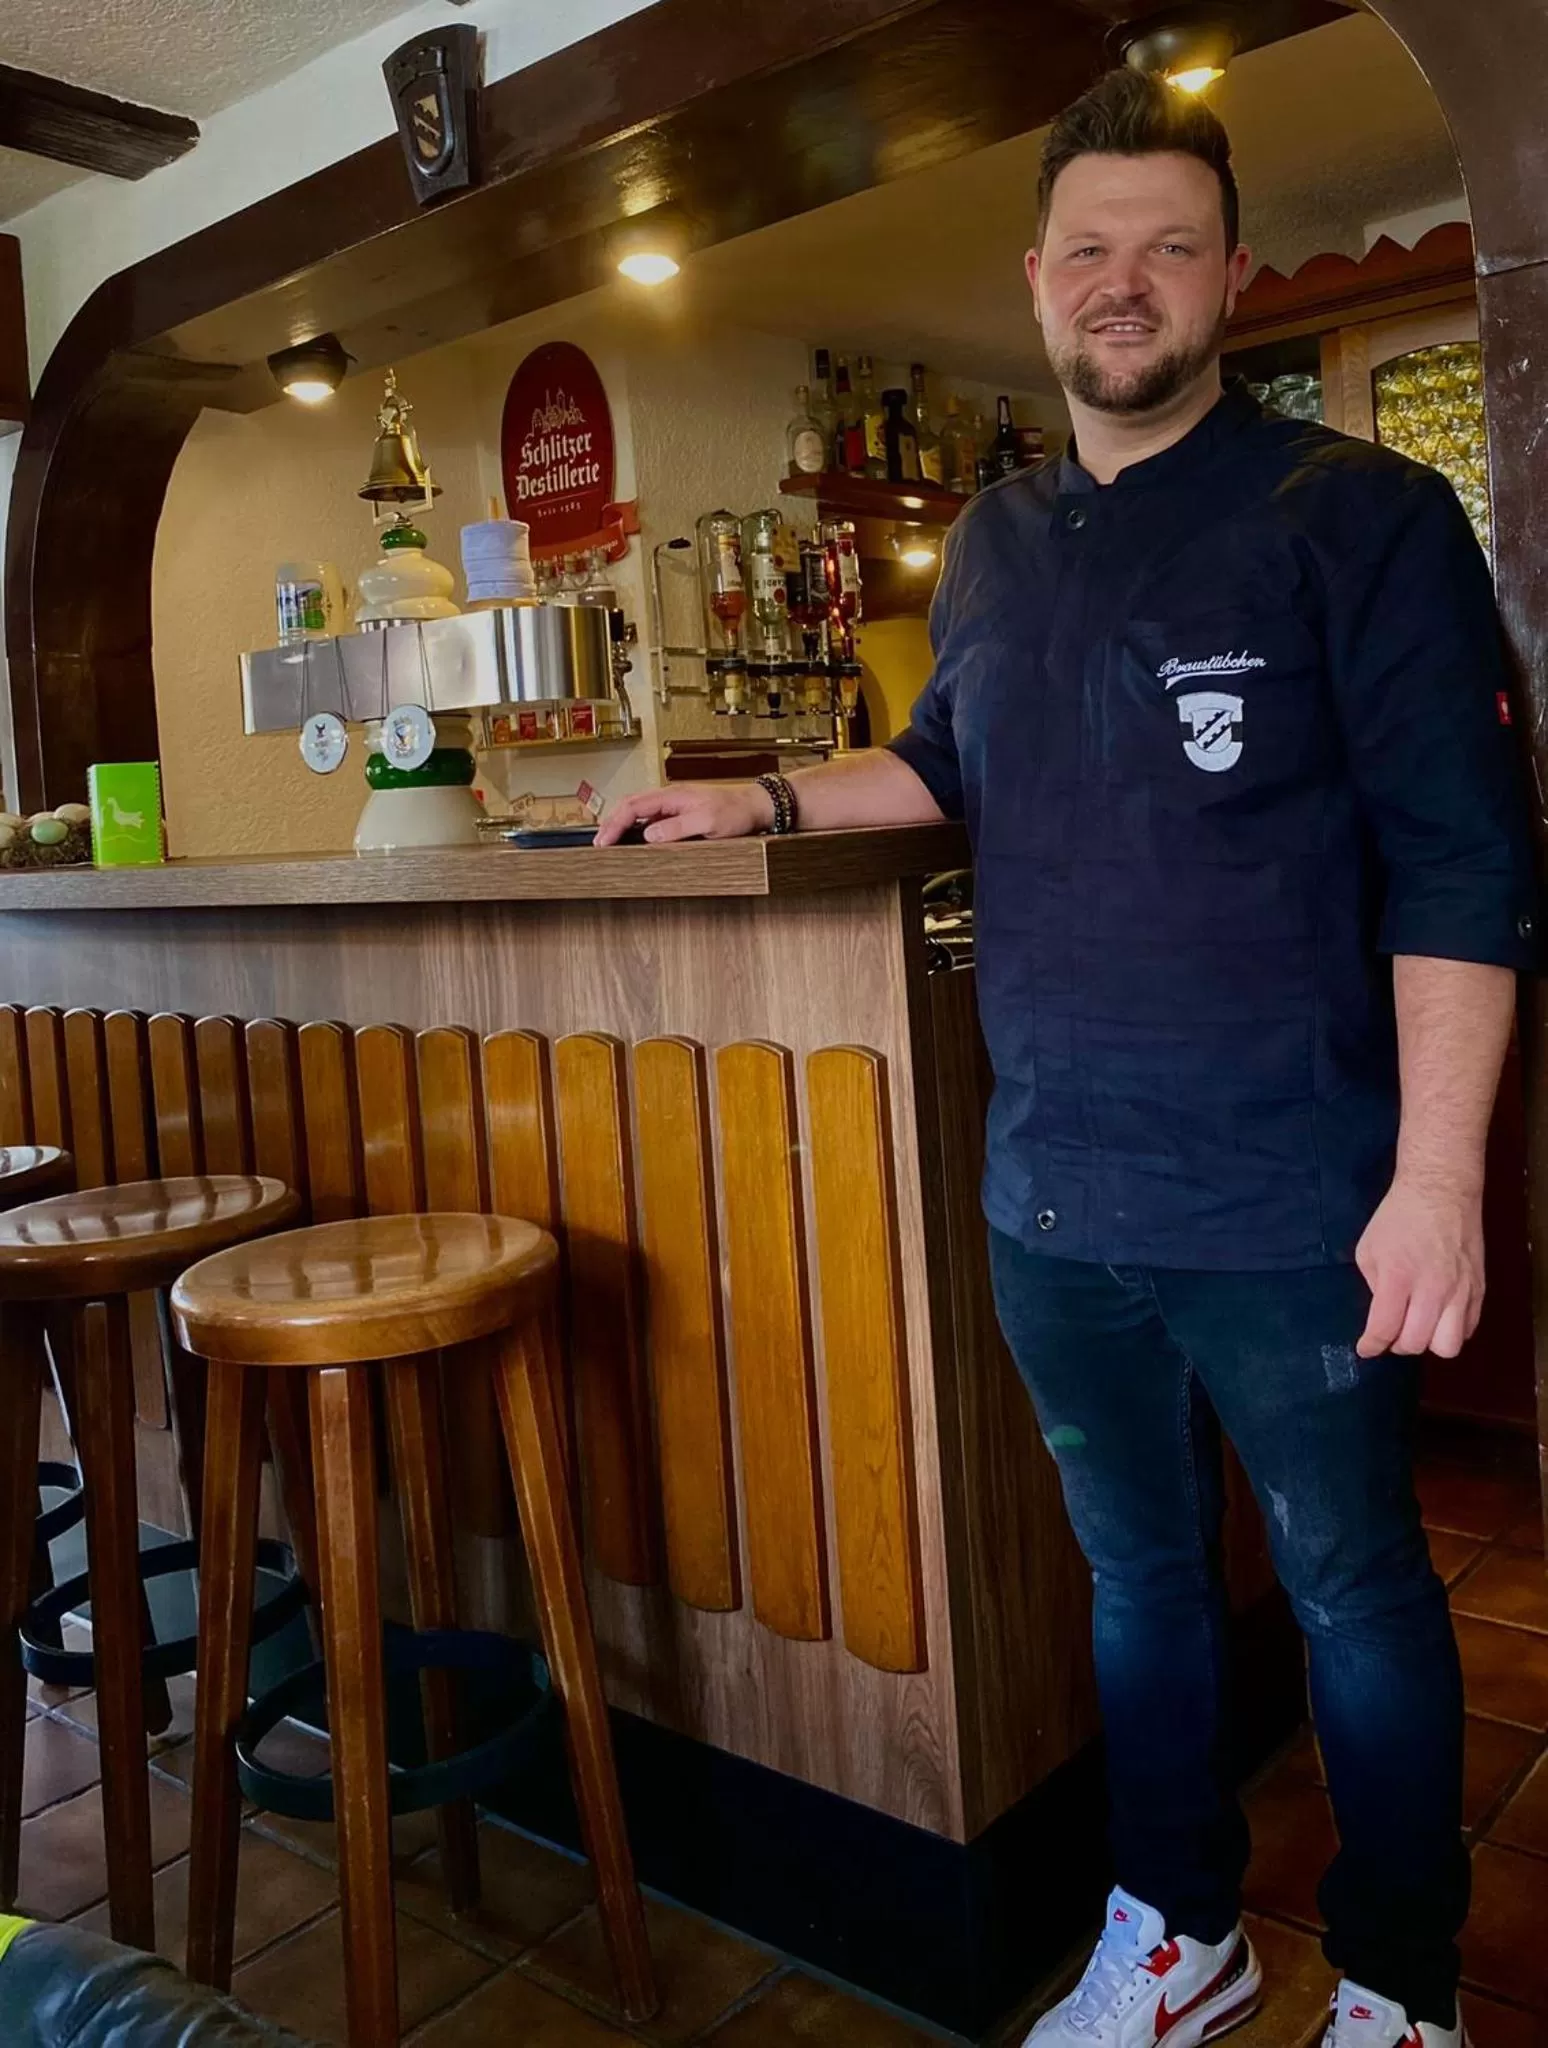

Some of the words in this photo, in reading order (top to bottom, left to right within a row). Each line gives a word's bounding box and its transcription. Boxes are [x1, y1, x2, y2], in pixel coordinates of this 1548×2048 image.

[519, 432, 592, 472] Schlitzer
[516, 458, 600, 502] Destillerie
[1157, 650, 1267, 679] Braustübchen
